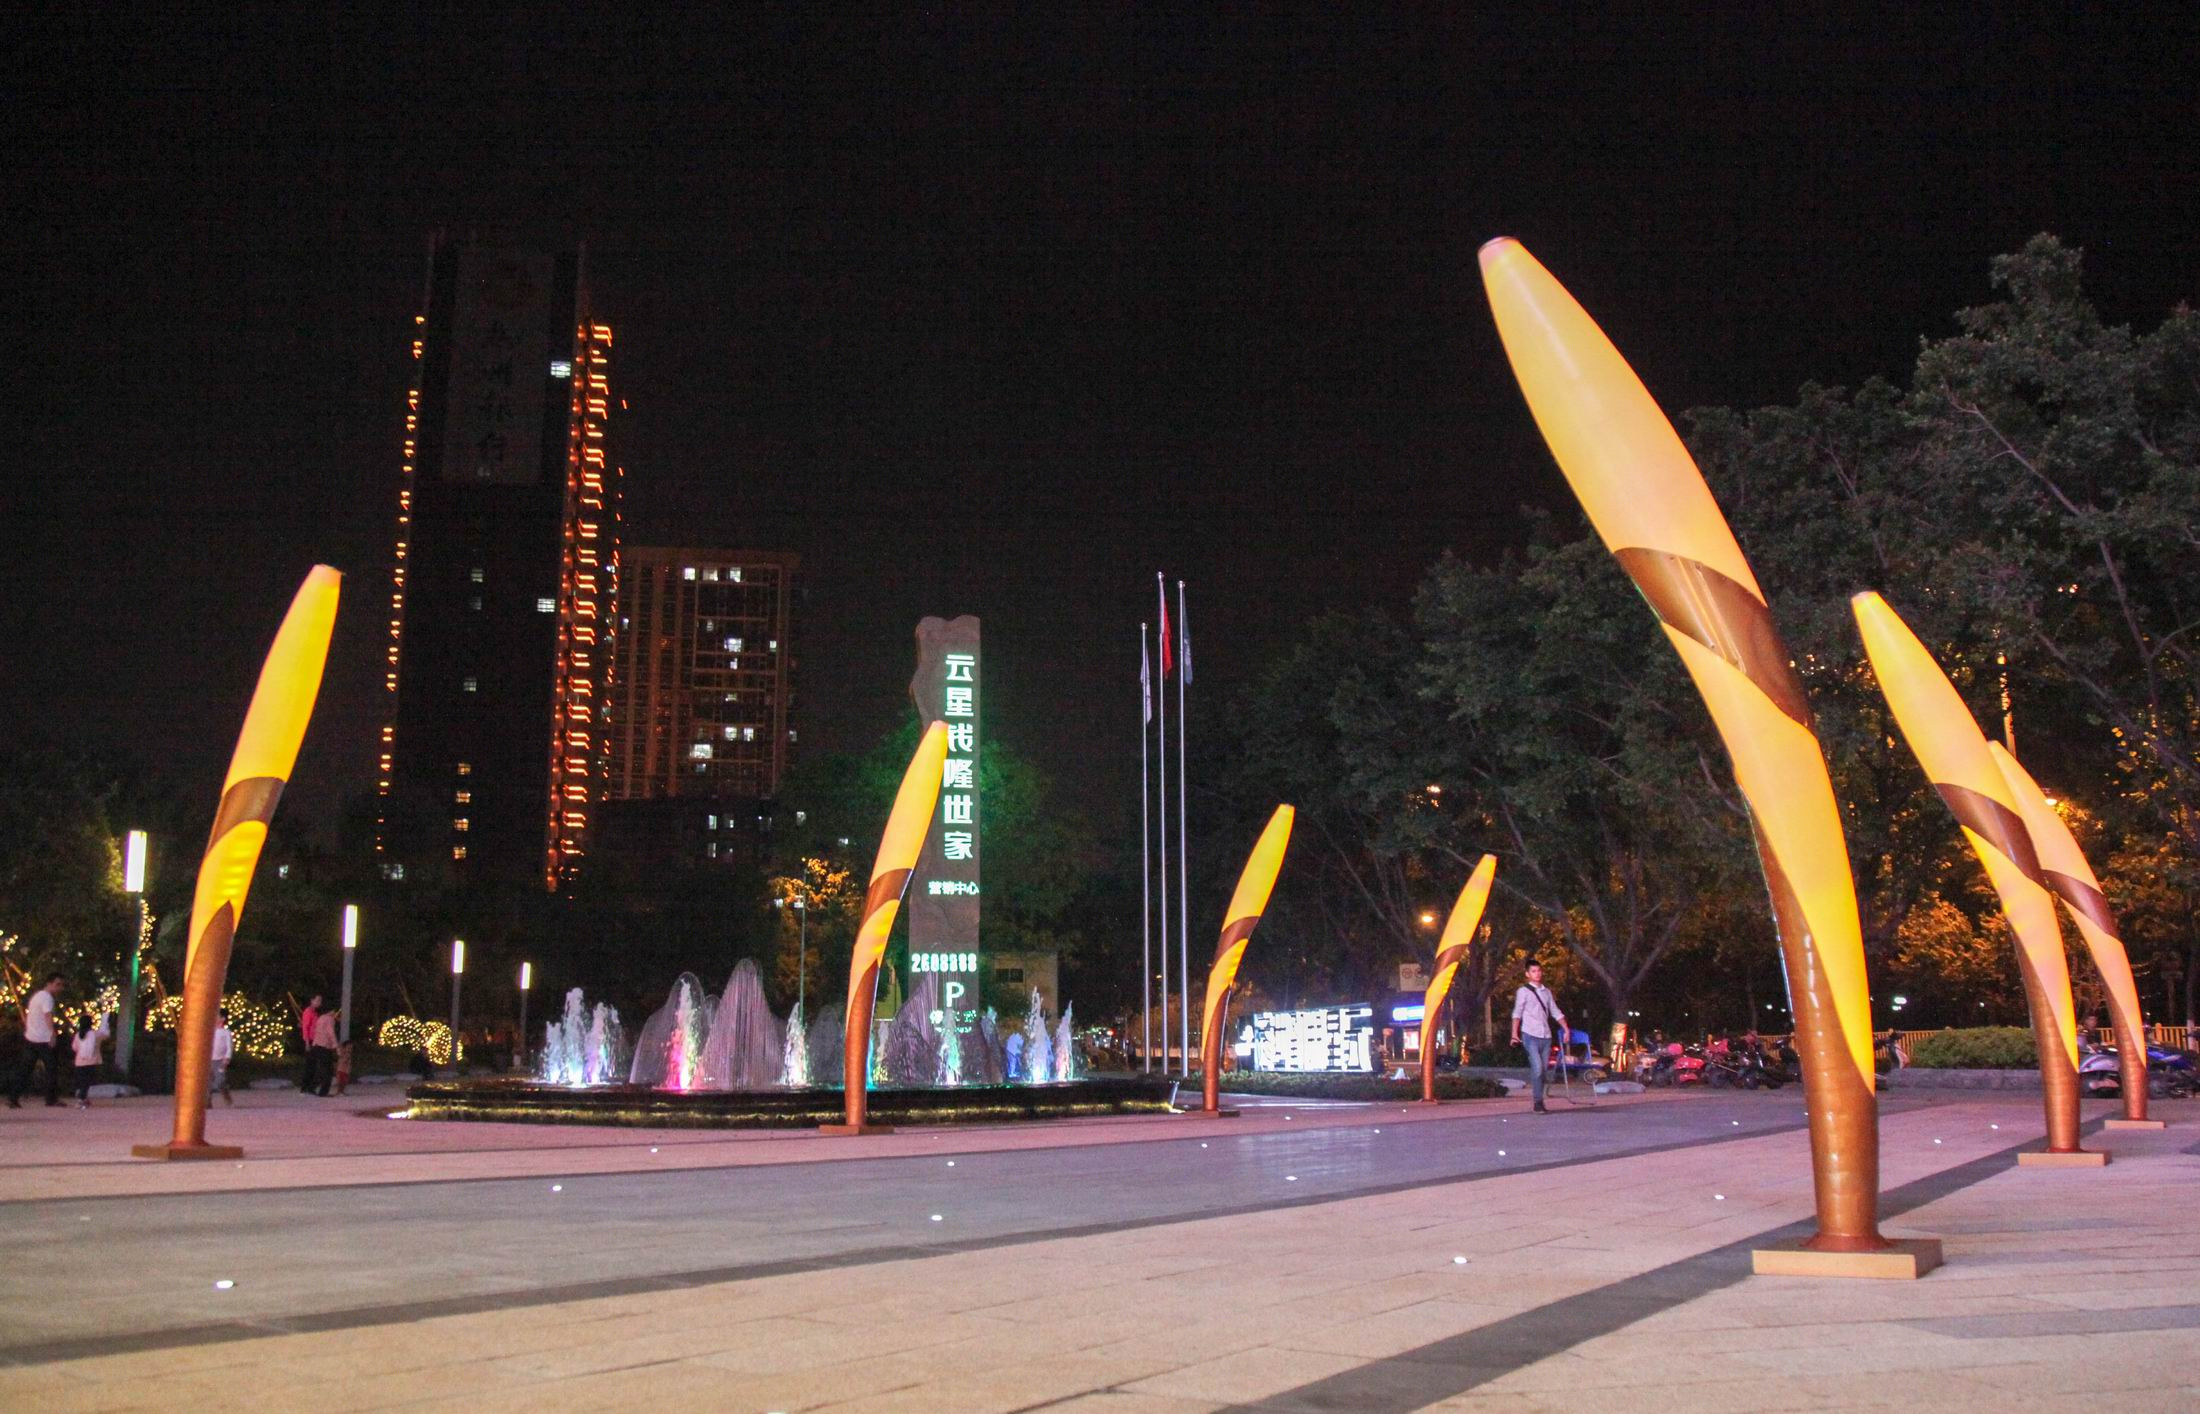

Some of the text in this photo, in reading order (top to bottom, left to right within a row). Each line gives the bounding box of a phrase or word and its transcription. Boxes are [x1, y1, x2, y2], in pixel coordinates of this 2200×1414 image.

[943, 654, 975, 860] 云星钱隆世家
[945, 981, 965, 1008] P
